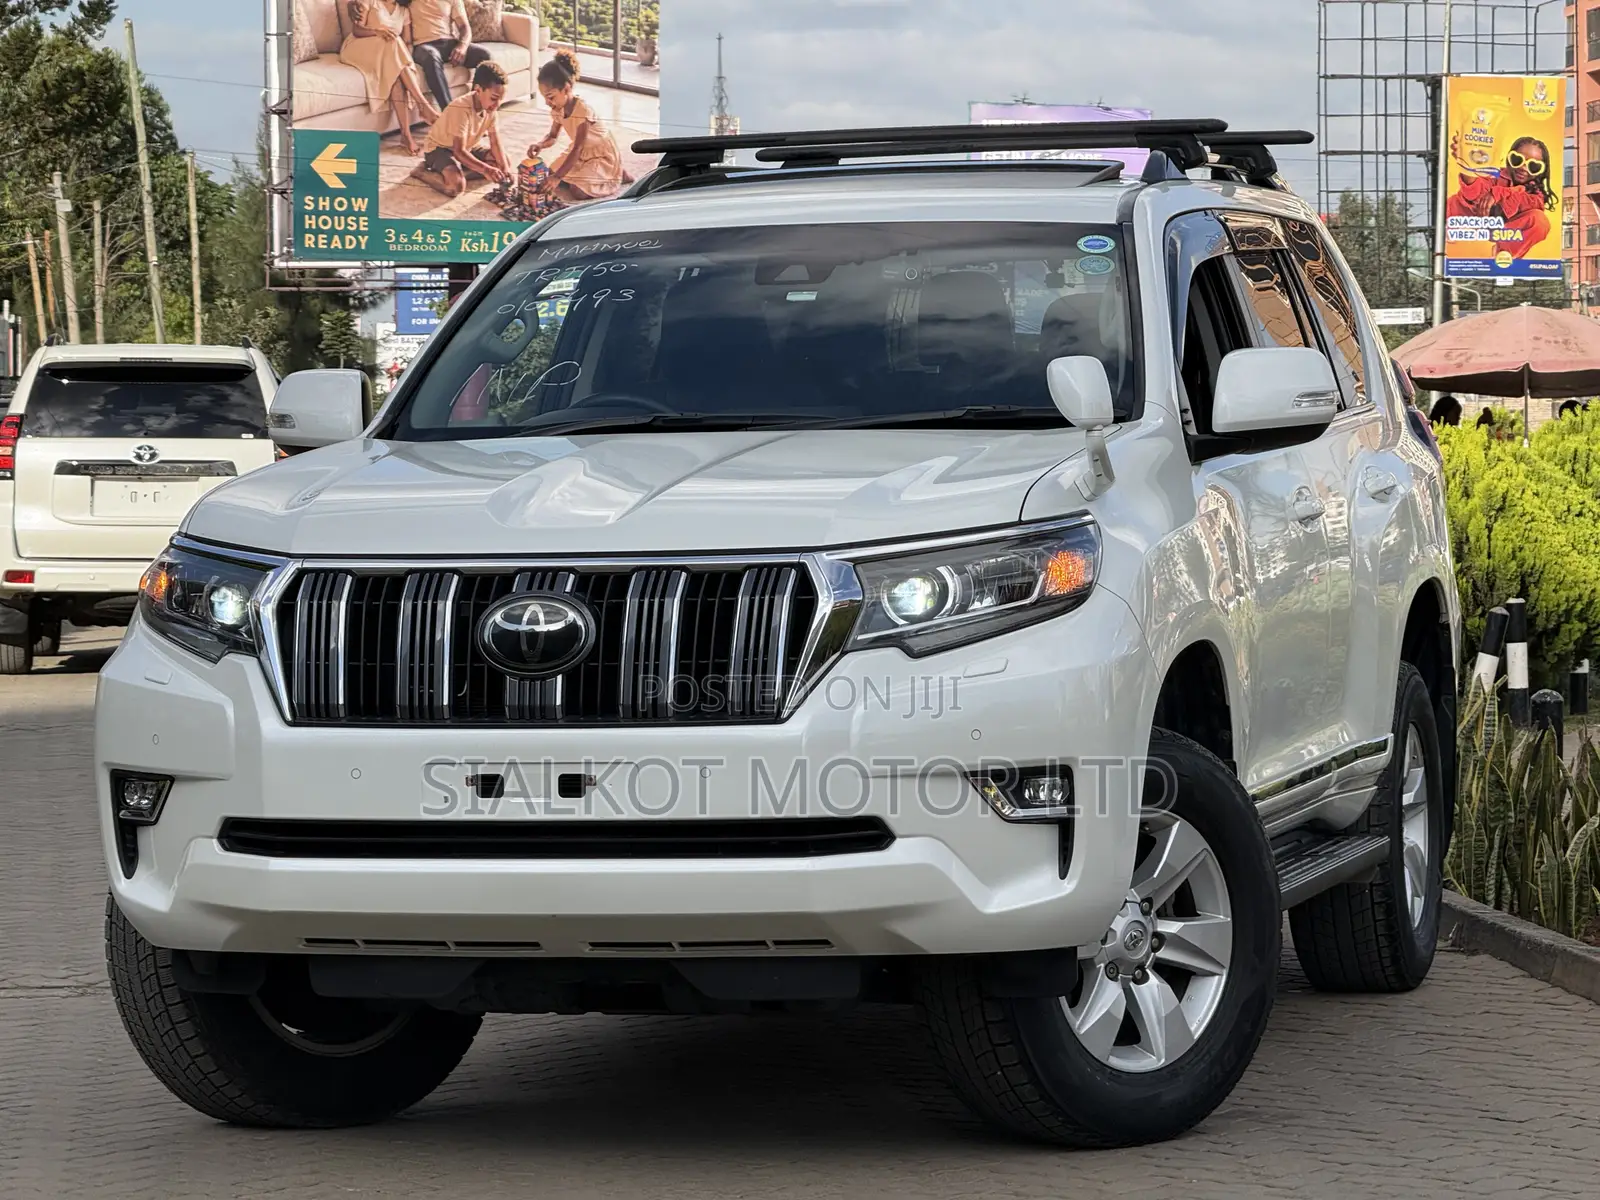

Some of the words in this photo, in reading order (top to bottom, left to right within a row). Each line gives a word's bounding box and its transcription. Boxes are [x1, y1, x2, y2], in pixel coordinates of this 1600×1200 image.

[1471, 126, 1488, 135] MINI
[1464, 134, 1494, 144] COOKIES
[303, 195, 369, 212] SHOW
[304, 214, 369, 231] HOUSE
[1449, 218, 1482, 227] SNACK
[1483, 218, 1503, 227] POA
[384, 228, 396, 243] 3
[399, 233, 408, 243] &
[411, 229, 424, 243] 4
[426, 234, 435, 243] &
[439, 229, 452, 244] 5
[1449, 230, 1475, 239] VIBEZ
[1478, 231, 1488, 239] NI
[1492, 229, 1524, 241] SUPA
[304, 233, 369, 250] READY
[389, 244, 449, 252] BEDROOM
